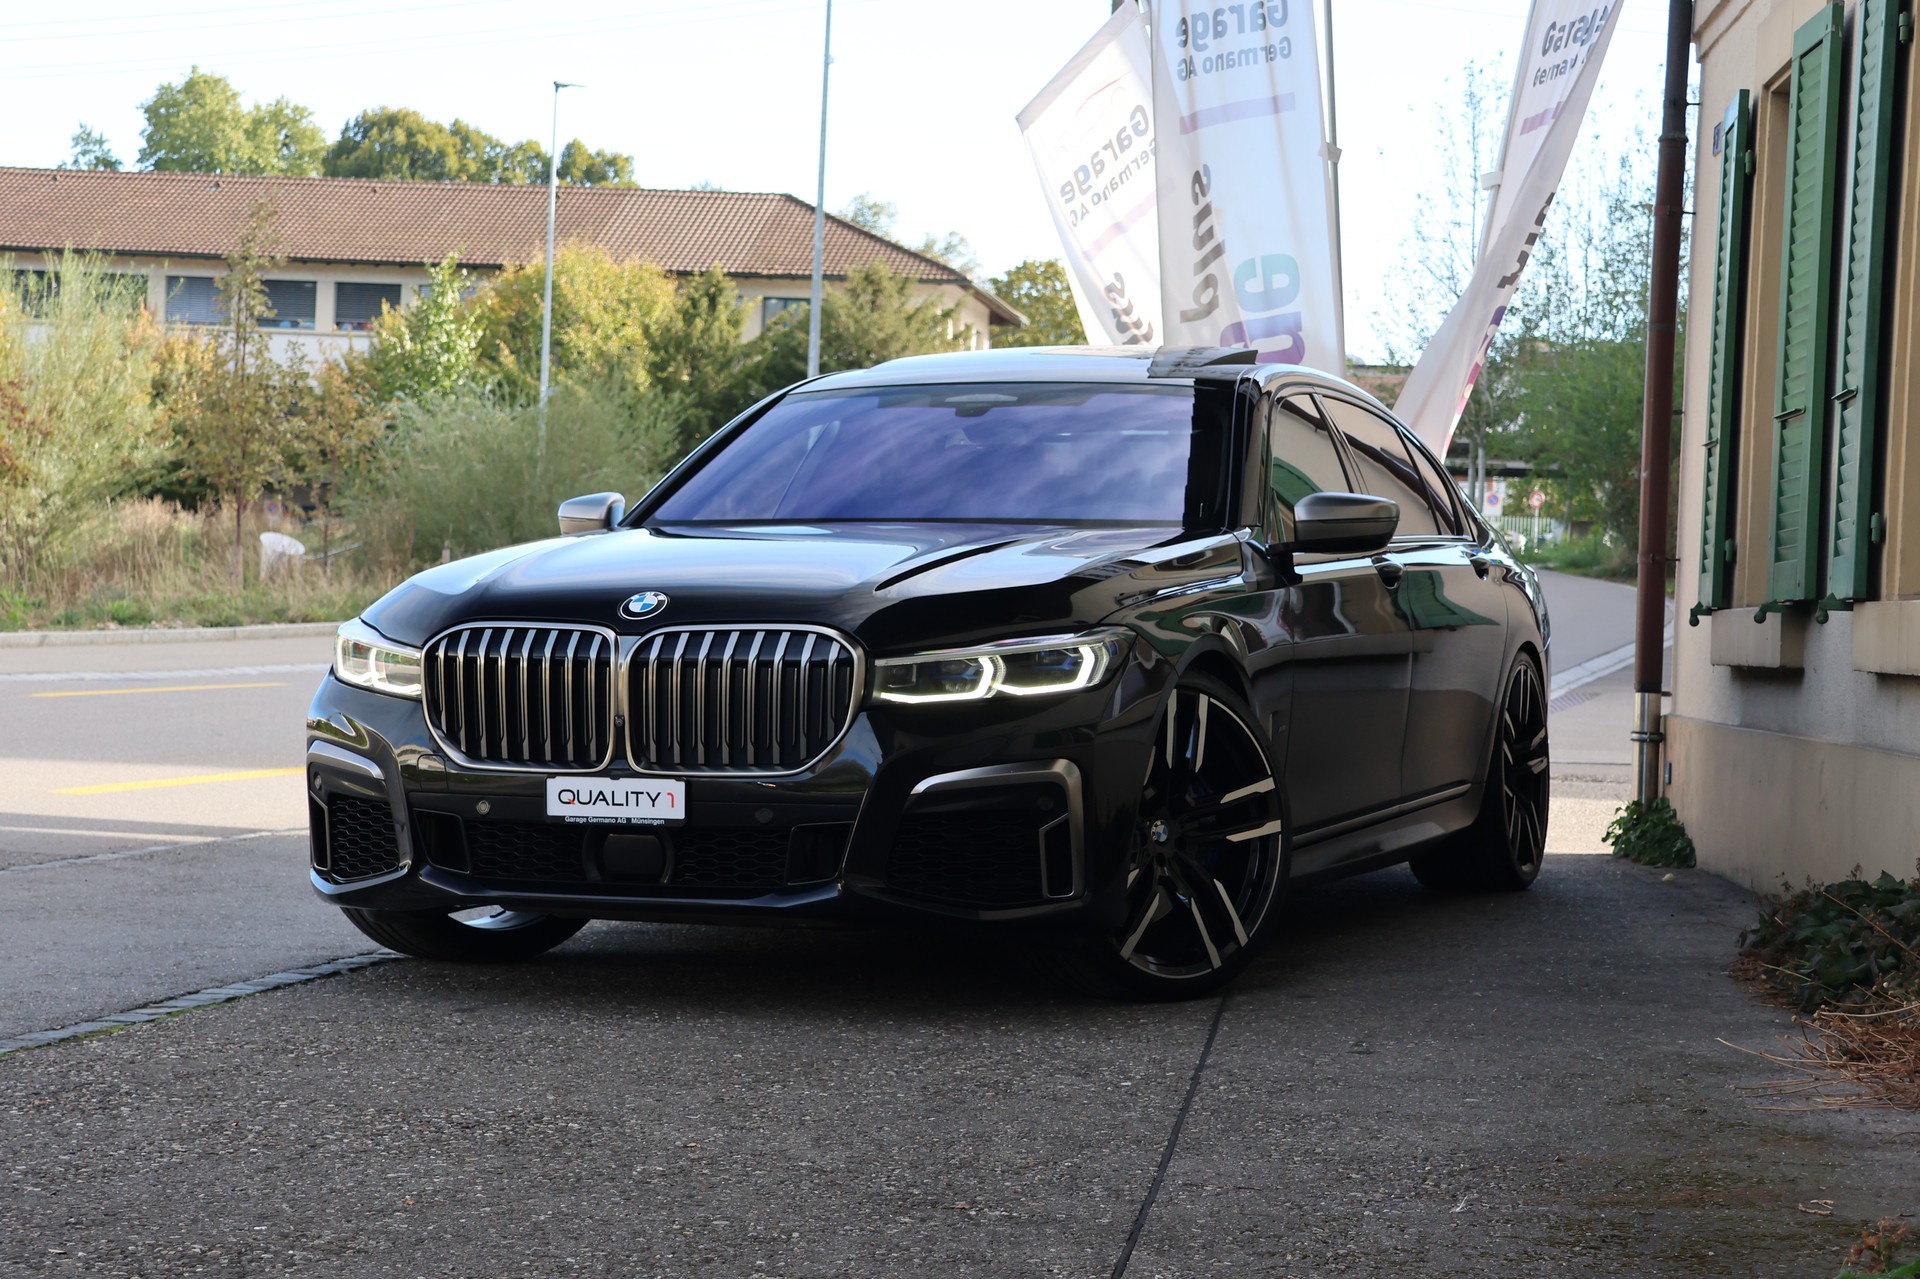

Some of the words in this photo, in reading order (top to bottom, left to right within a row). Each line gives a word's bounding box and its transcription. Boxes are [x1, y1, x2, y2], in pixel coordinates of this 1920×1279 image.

[558, 789, 661, 808] QUALITY
[667, 792, 675, 808] 1
[564, 815, 587, 824] Garage
[588, 816, 616, 824] Germano
[631, 817, 665, 825] Münsingen
